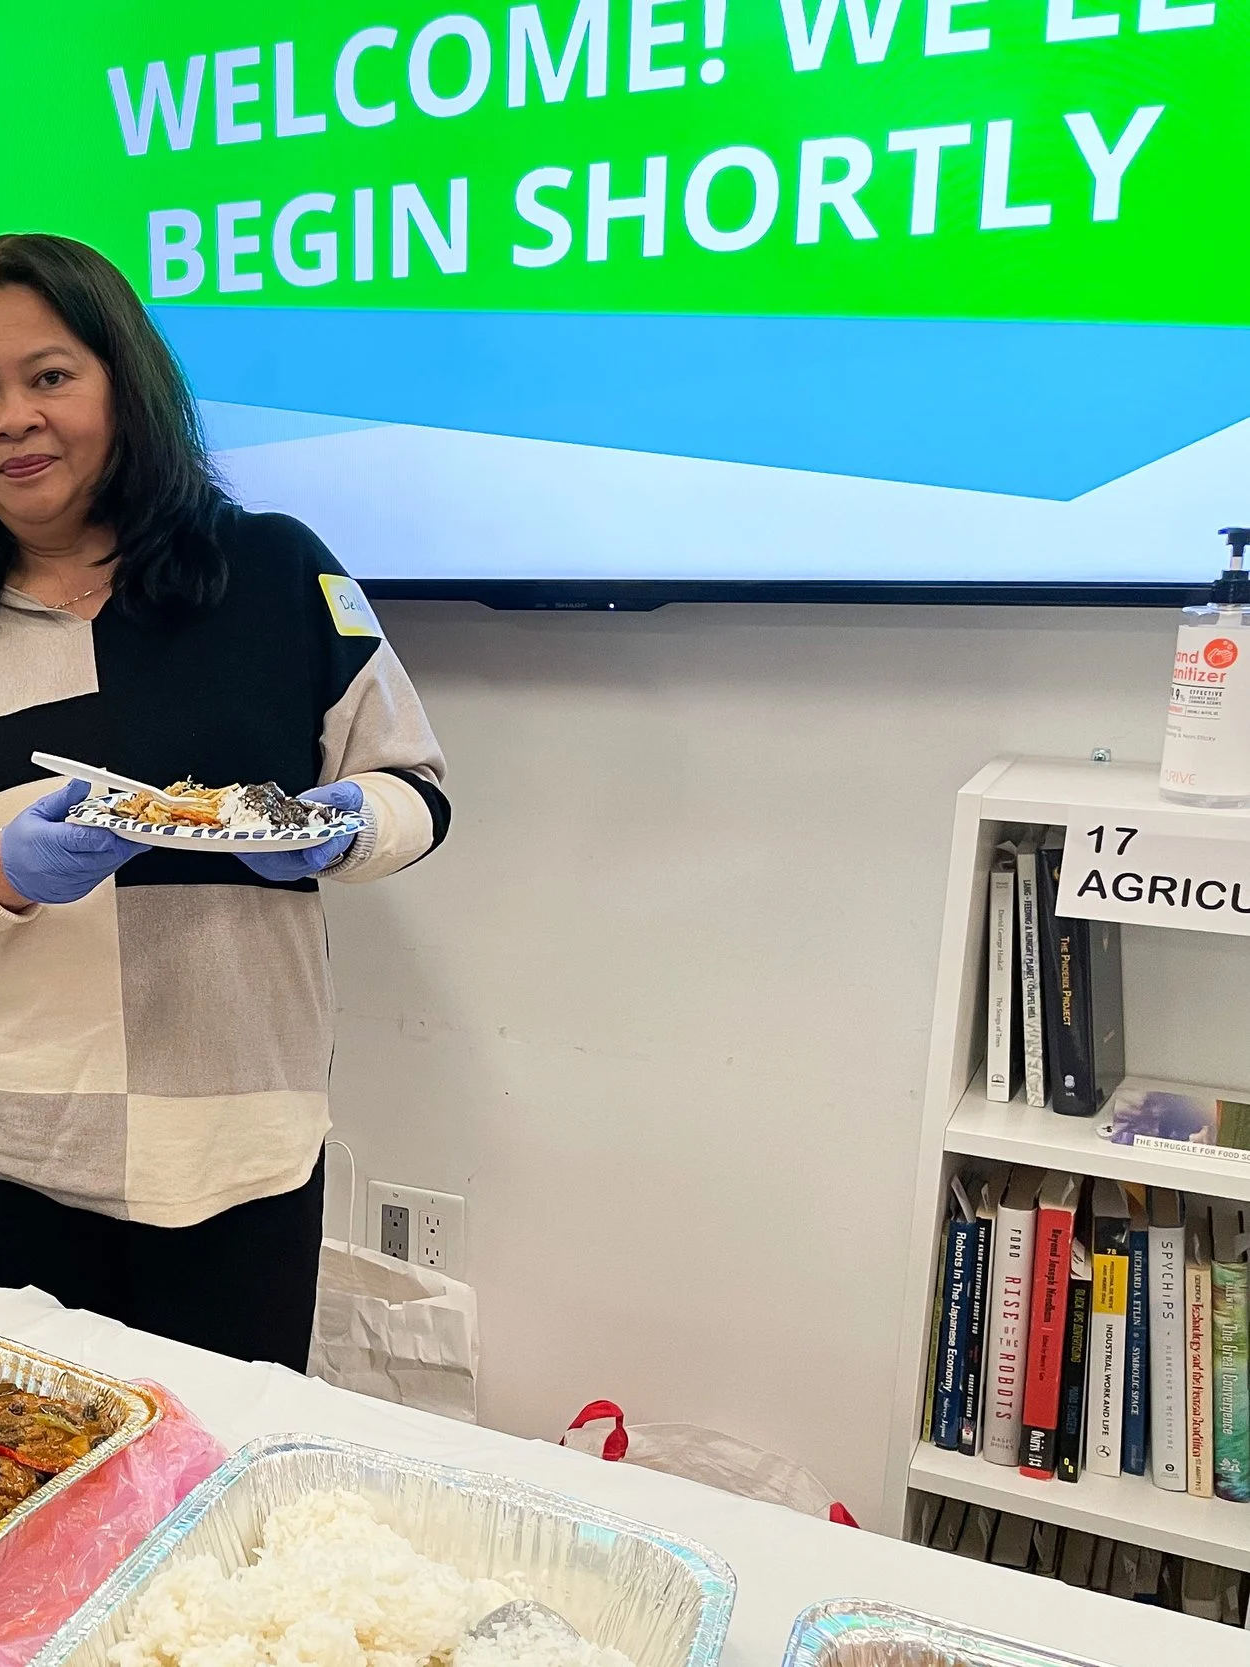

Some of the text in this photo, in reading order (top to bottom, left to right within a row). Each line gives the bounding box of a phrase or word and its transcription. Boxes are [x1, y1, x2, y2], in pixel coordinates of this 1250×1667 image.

[107, 0, 726, 156] WELCOME!
[149, 105, 1165, 298] BEGIN SHORTLY
[1087, 825, 1138, 856] 17
[1077, 869, 1250, 914] AGRICU
[1023, 900, 1033, 924] FEEDING
[1025, 932, 1034, 957] HUNGRY
[1060, 936, 1072, 1026] THE PHOENIX PROJECT
[1135, 1138, 1151, 1147] THE
[1154, 1141, 1197, 1153] STRUGGLE
[1200, 1147, 1216, 1155] FOR
[1218, 1150, 1240, 1159] FOOD
[954, 1231, 967, 1267] Robots
[1009, 1229, 1022, 1258] FORD
[1050, 1228, 1063, 1257] Beyond
[974, 1263, 984, 1299] EVERYTHING
[1046, 1259, 1060, 1285] Joseph
[1133, 1250, 1142, 1289] RICHARD
[951, 1281, 963, 1300] The
[1004, 1276, 1022, 1320] RISE
[947, 1302, 961, 1346] Japanese
[1132, 1300, 1141, 1326] ETLIN
[1190, 1303, 1204, 1351] Technology
[1000, 1338, 1019, 1347] THE
[1104, 1324, 1113, 1373] INDUSTRIAL
[1221, 1323, 1238, 1342] The
[941, 1348, 957, 1392] Economy
[1131, 1346, 1141, 1389] SYMBOLIC
[1222, 1345, 1236, 1372] Great
[996, 1353, 1017, 1420] ROBOTS
[1103, 1374, 1112, 1398] WORK
[1131, 1390, 1140, 1416] SPACE
[1221, 1374, 1236, 1434] Convergence
[1030, 1431, 1046, 1451] Osiris
[1192, 1417, 1205, 1457] Condition
